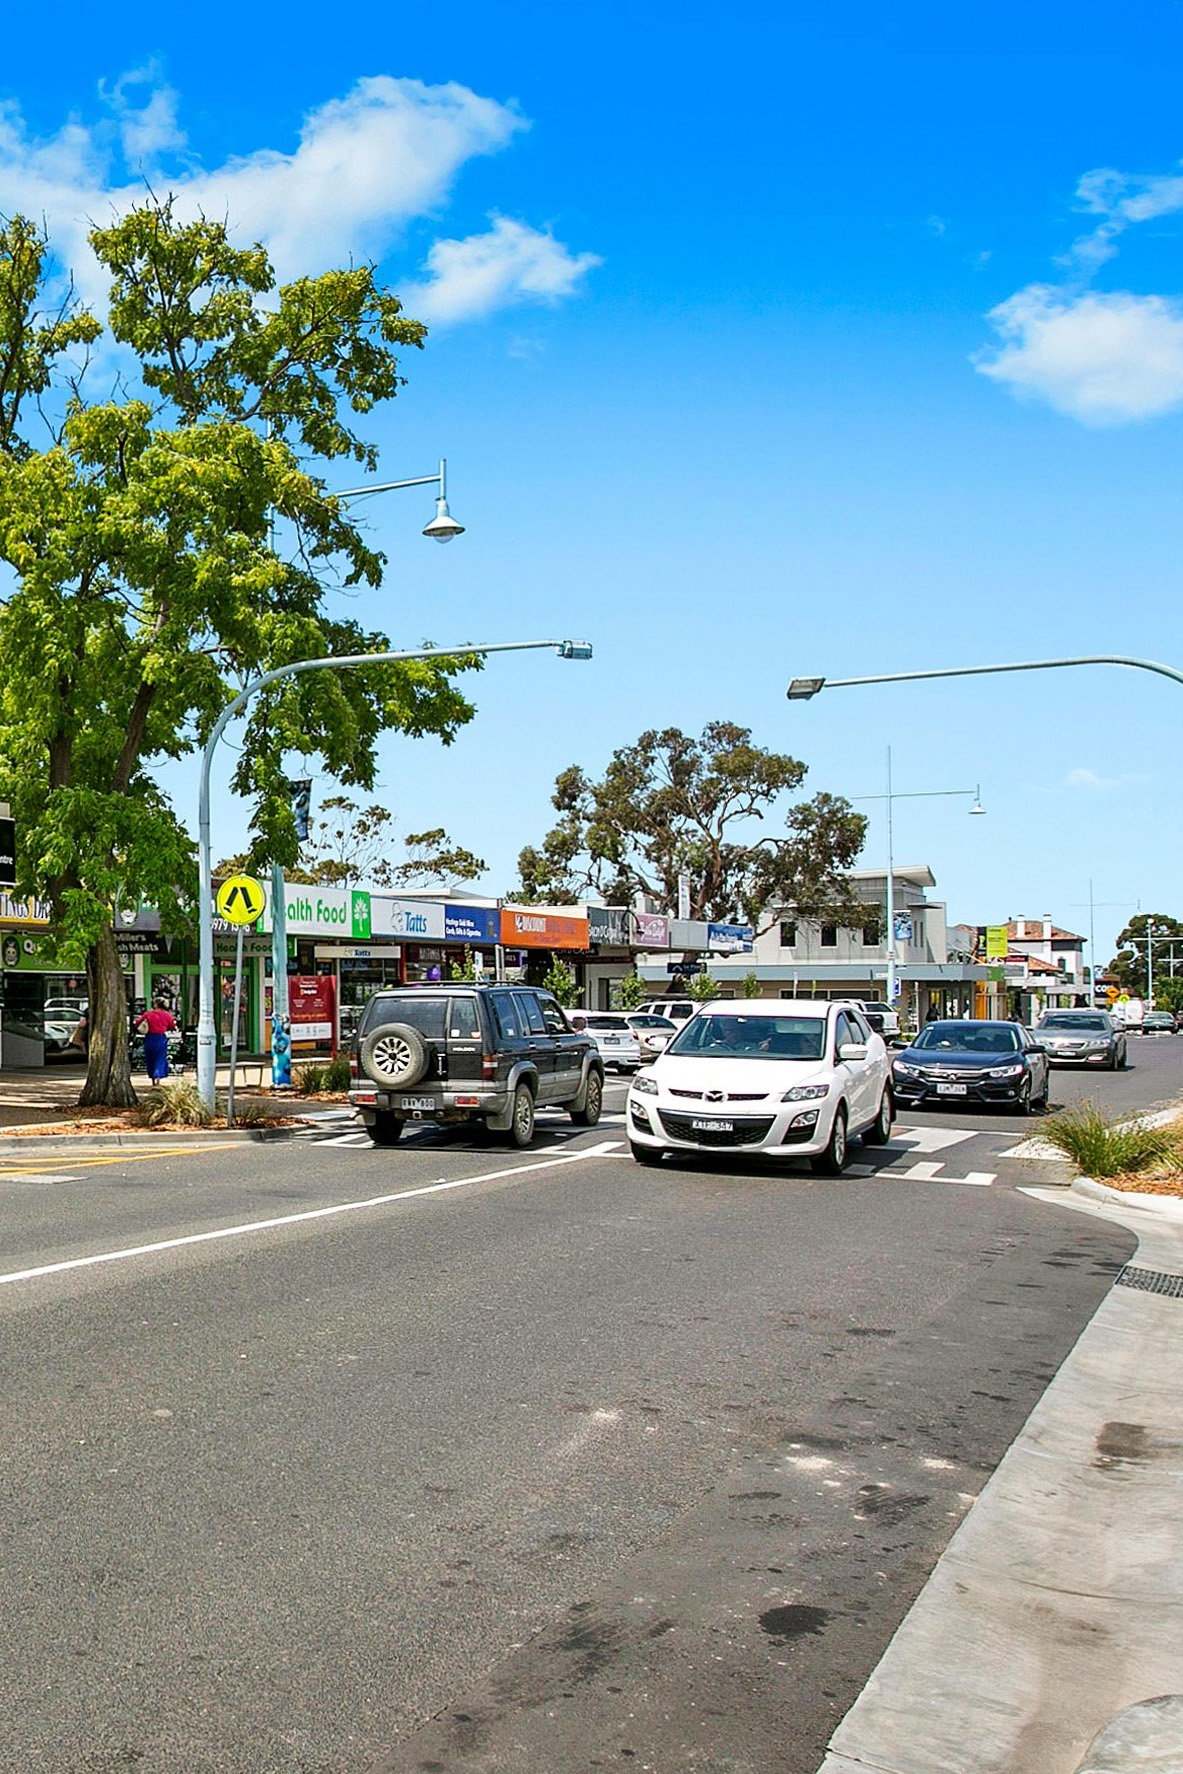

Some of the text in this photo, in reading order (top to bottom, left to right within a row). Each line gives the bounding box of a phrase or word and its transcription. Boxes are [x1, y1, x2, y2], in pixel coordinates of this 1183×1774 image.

[284, 897, 347, 924] alth Food
[211, 917, 229, 931] 979
[405, 911, 428, 933] Tatts
[116, 943, 159, 952] sh Meats
[217, 942, 248, 952] Healh
[354, 949, 371, 957] Tatts
